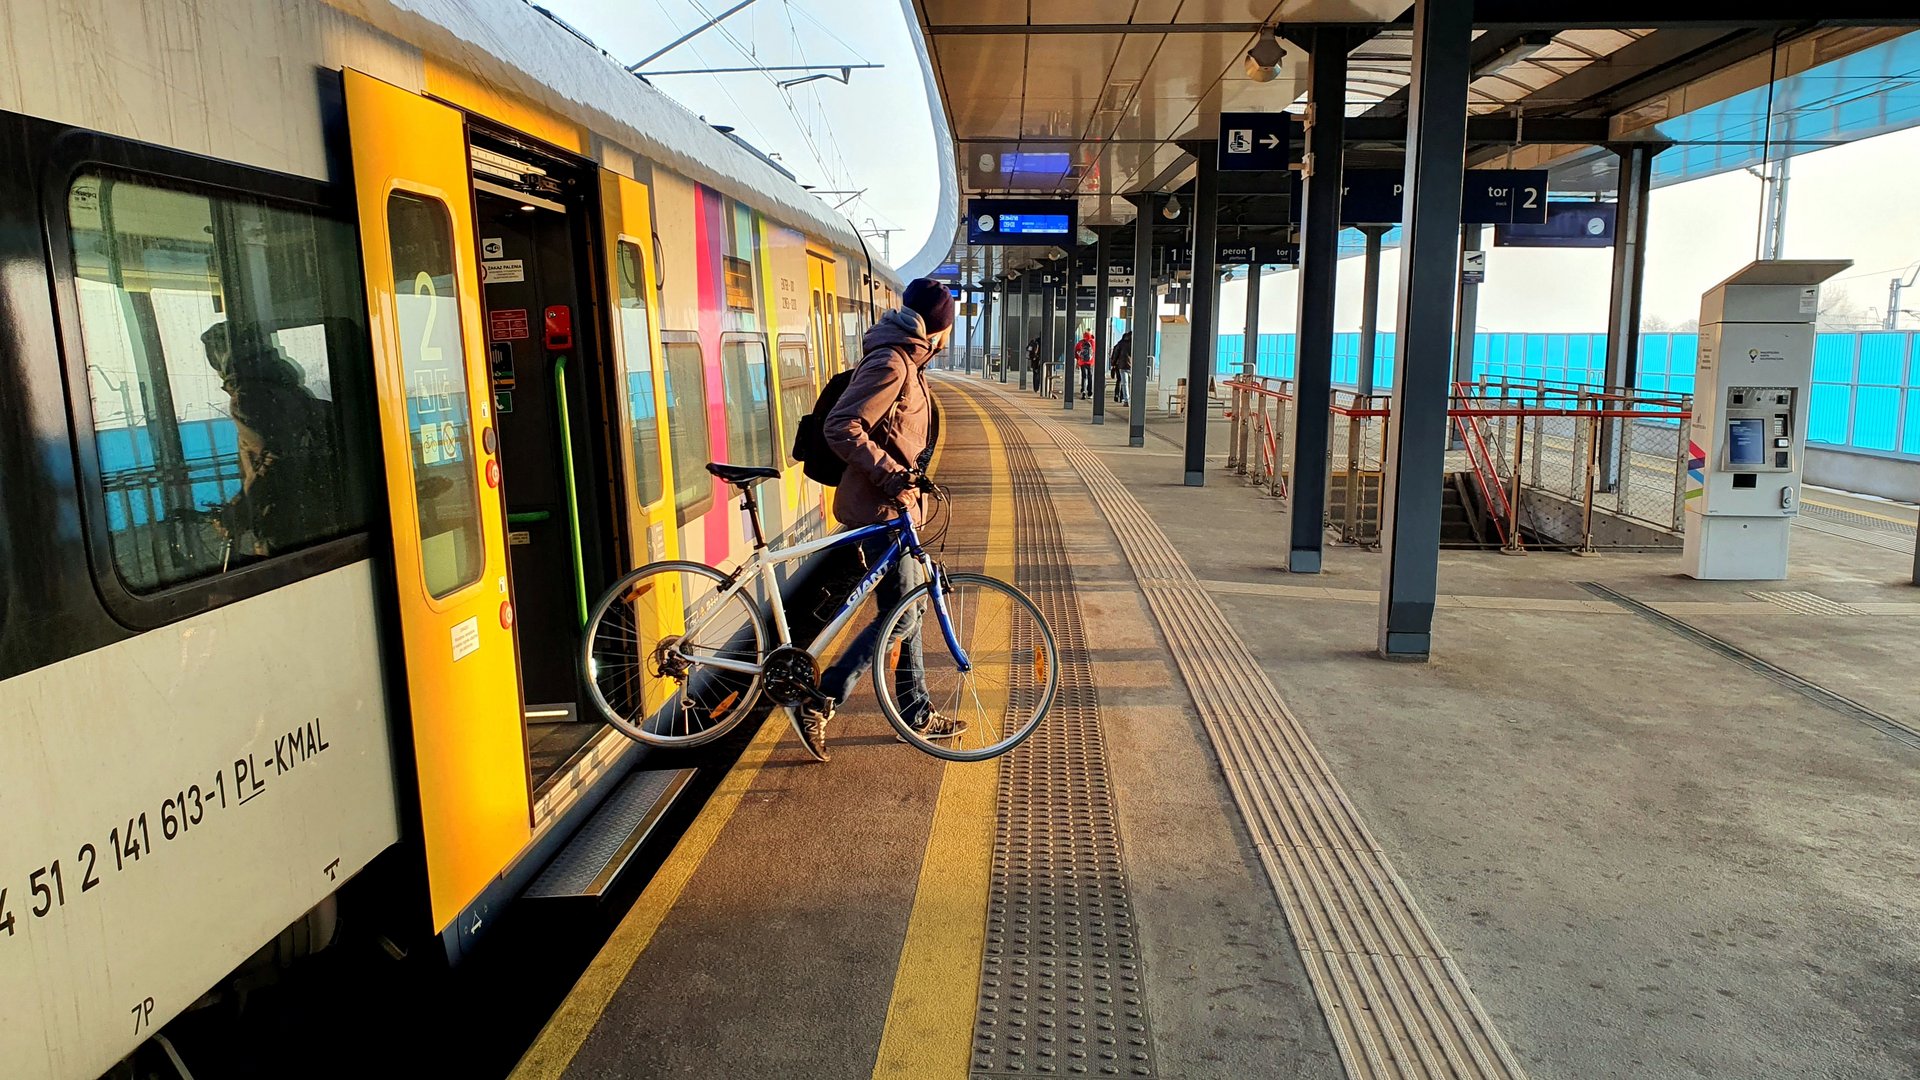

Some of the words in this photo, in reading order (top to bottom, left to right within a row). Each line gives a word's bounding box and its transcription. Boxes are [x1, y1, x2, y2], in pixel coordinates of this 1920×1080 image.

[1488, 186, 1509, 197] tor
[1522, 187, 1538, 209] 2
[1171, 248, 1177, 261] 1
[1222, 247, 1247, 257] peron
[1249, 246, 1256, 261] 1
[1276, 248, 1289, 257] tor
[414, 271, 443, 361] 2
[846, 560, 890, 607] GIANT
[29, 859, 66, 918] 51
[77, 842, 101, 893] 2
[109, 811, 151, 872] 141
[160, 769, 227, 841] 613-1
[131, 996, 155, 1036] 7P
